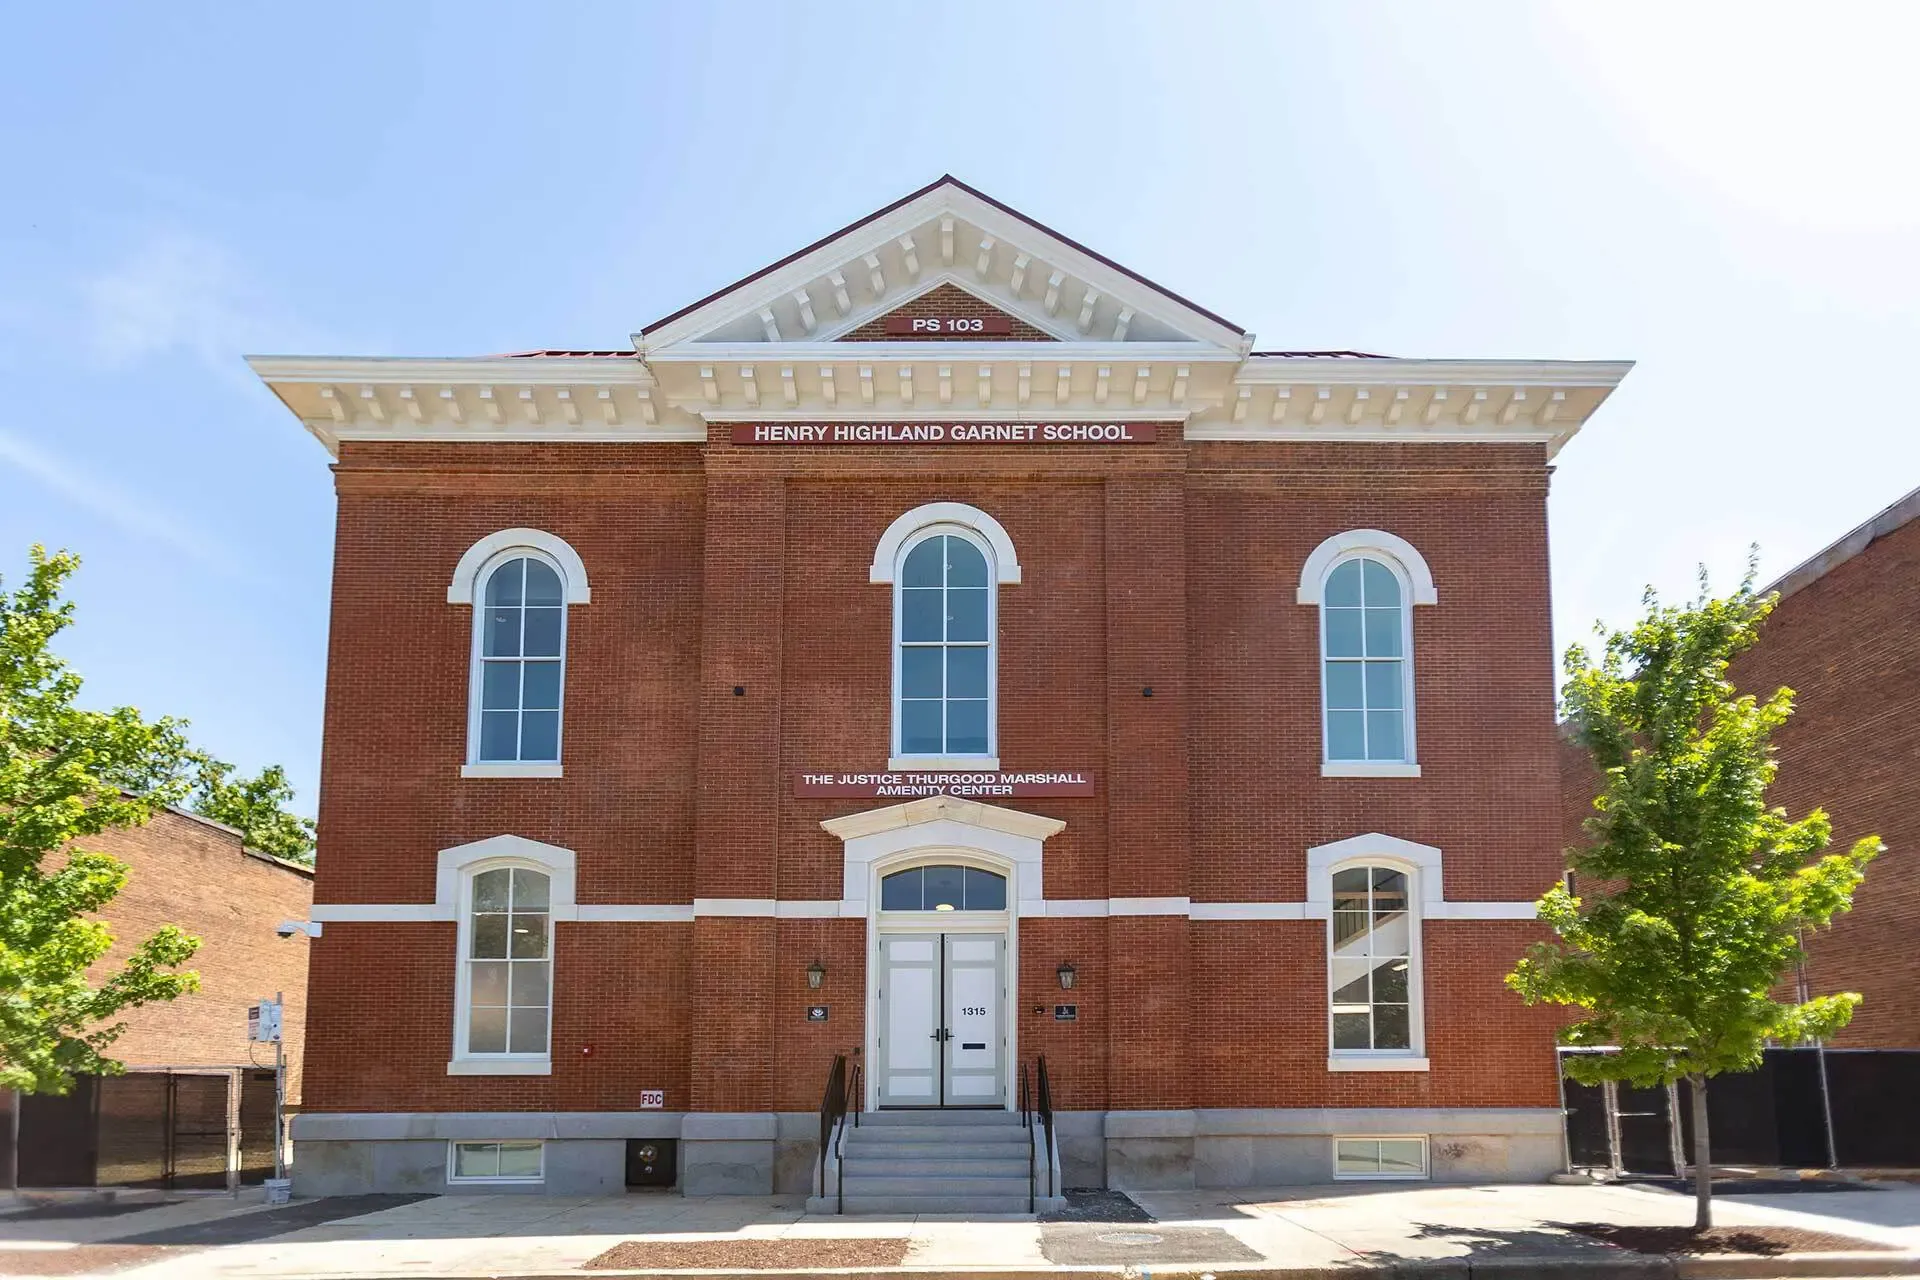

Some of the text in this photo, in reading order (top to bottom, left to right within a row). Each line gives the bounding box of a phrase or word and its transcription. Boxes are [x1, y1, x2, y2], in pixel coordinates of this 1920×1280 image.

[912, 319, 983, 332] PS 103
[754, 424, 1133, 441] HENRY HIGHLAND GARNET SCHOOL
[803, 774, 1086, 785] THE JUSTICE THURGOOD MARSHALL
[876, 785, 1013, 796] AMENITY CENTER
[962, 1007, 986, 1016] 1315
[641, 1093, 662, 1105] FDC
